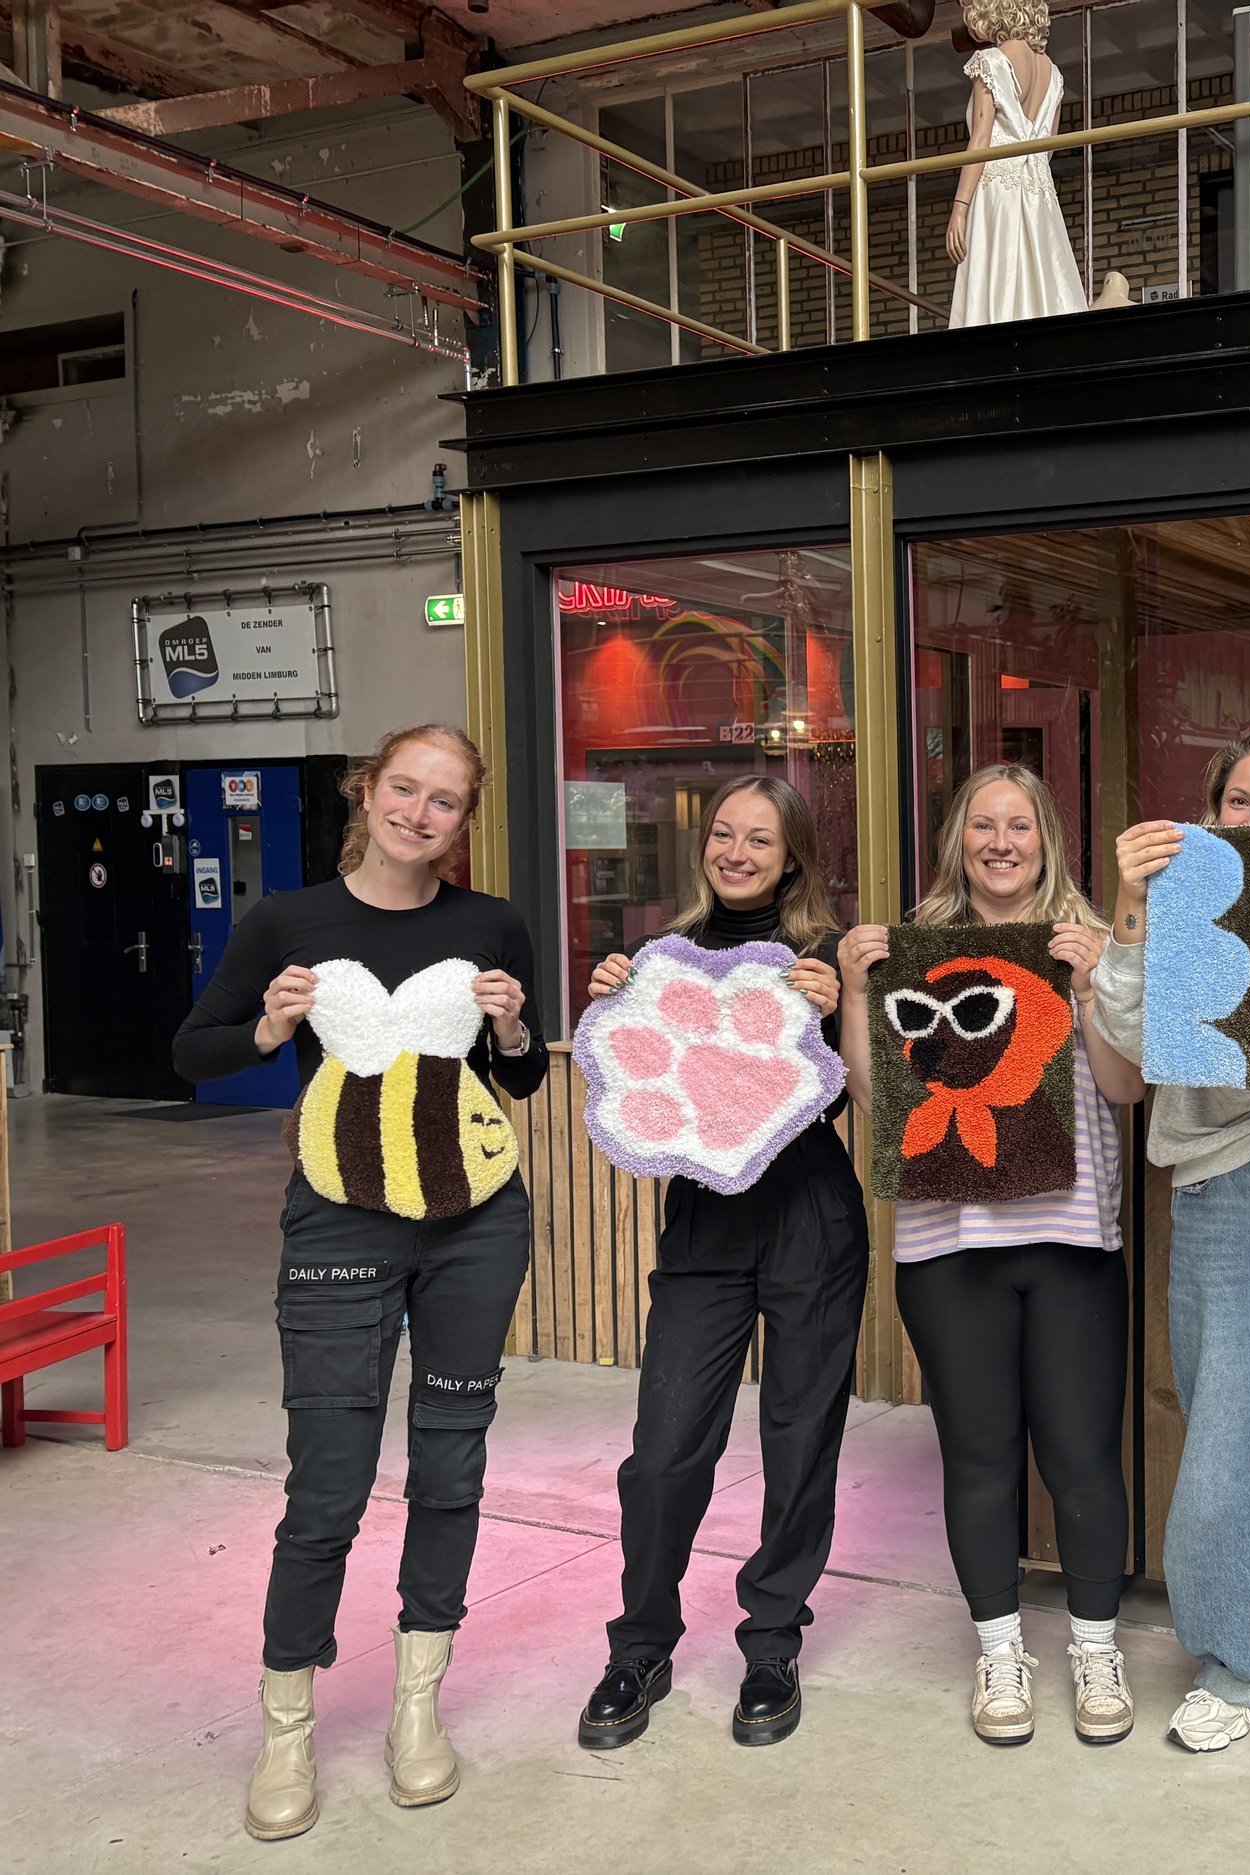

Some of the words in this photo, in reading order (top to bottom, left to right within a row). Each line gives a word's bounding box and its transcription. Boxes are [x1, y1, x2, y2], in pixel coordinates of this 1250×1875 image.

[241, 621, 251, 630] DE
[253, 619, 283, 629] ZENDER
[165, 637, 208, 645] OMROEP
[165, 644, 208, 662] ML5
[256, 646, 271, 654] VAN
[232, 671, 262, 681] MIDDEN
[263, 670, 299, 680] LIMBURG
[289, 1268, 327, 1281] DAILY
[331, 1267, 377, 1281] PAPER
[426, 1373, 464, 1392] DAILY
